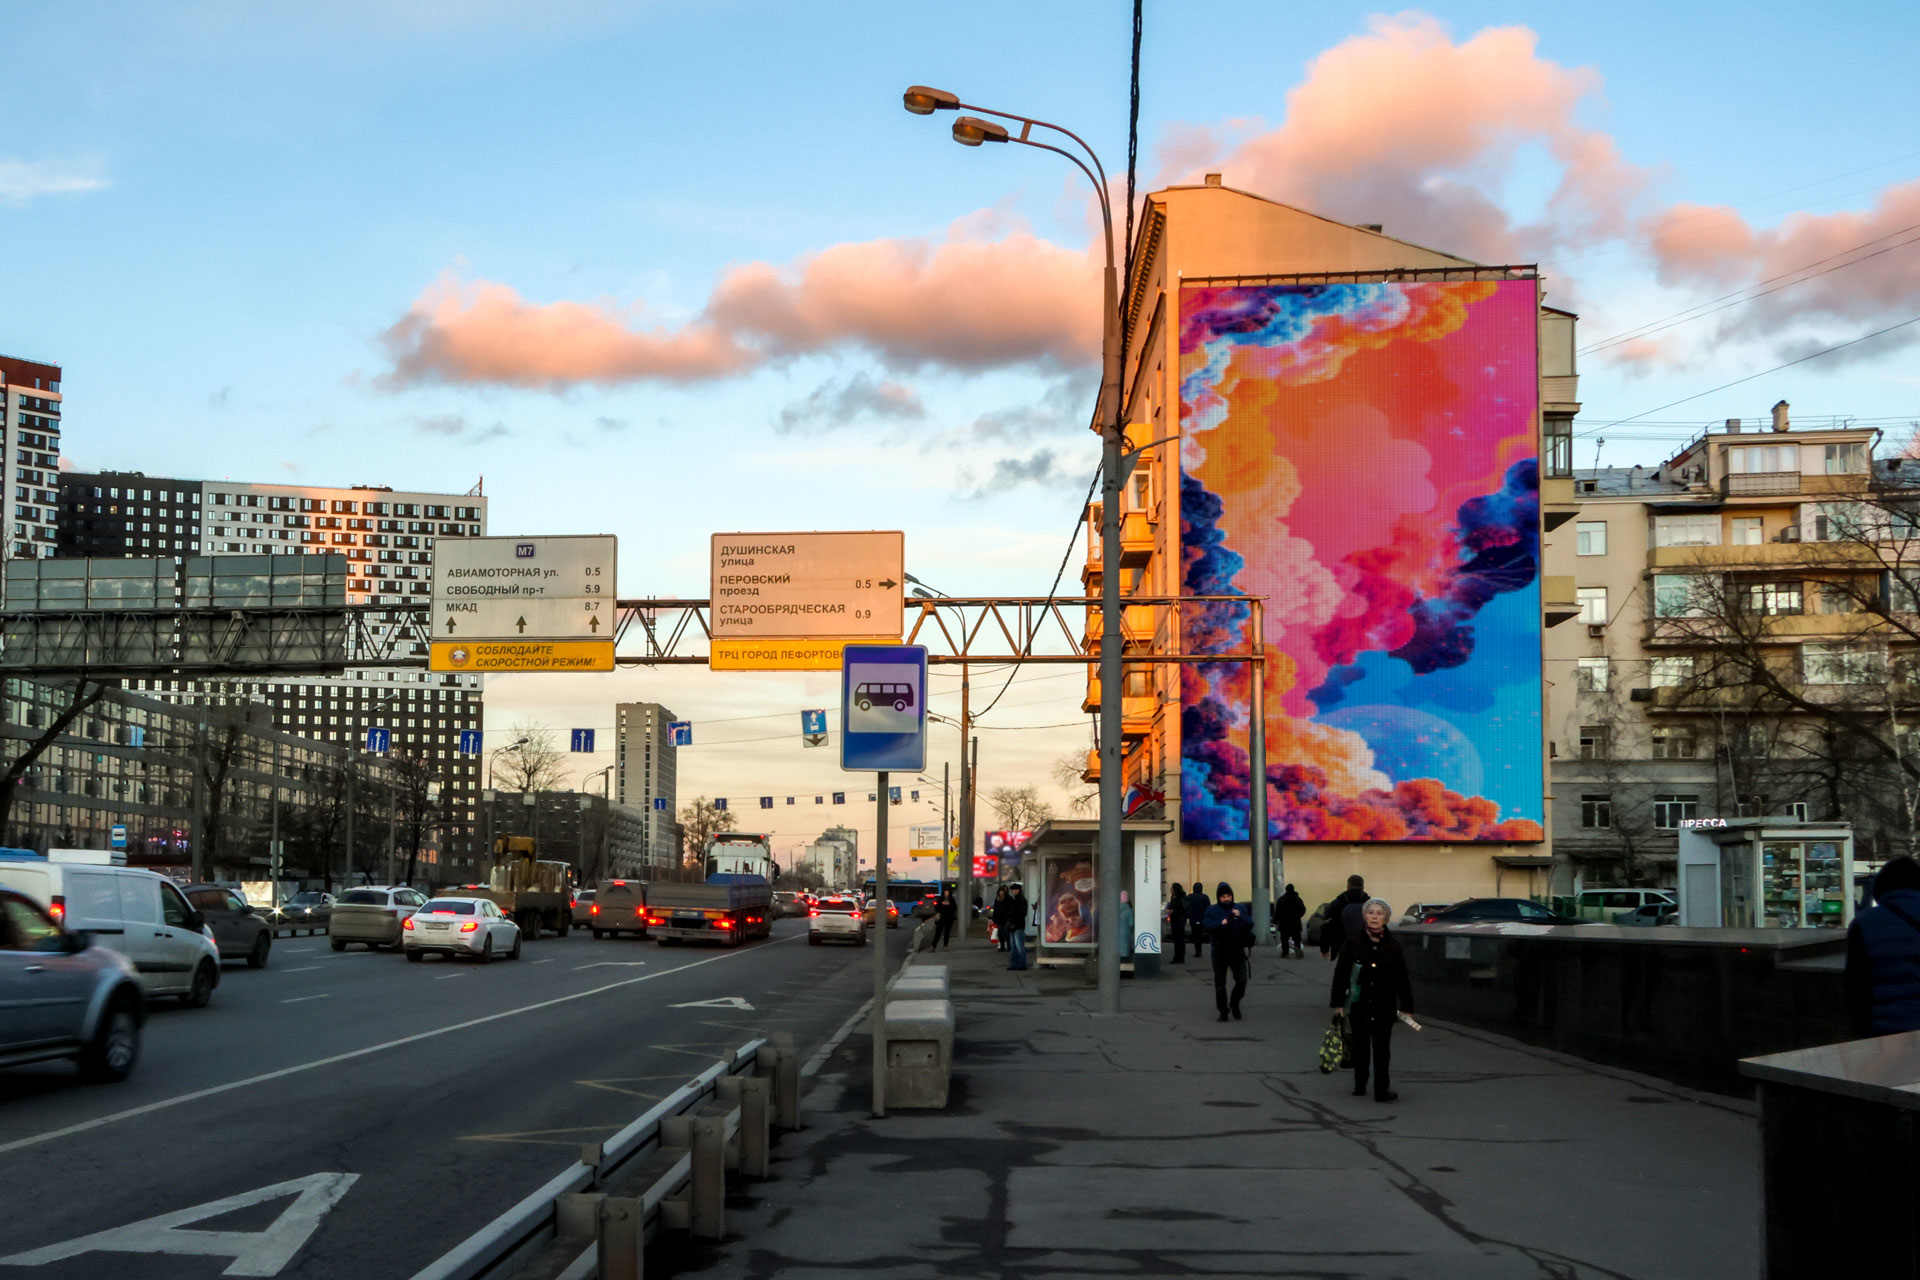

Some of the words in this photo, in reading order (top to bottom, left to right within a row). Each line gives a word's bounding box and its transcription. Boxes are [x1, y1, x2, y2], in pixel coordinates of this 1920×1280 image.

[720, 545, 795, 556] ДУШИНСКАЯ
[720, 558, 755, 567] улица
[447, 568, 541, 578] АВИАМОТОРНАЯ
[543, 569, 559, 580] ул.
[585, 567, 601, 577] 0.5
[720, 573, 791, 585] ПЕРОВСКИЙ
[855, 579, 872, 589] 0.5
[446, 584, 520, 596] СВОБОДНЫЙ
[522, 587, 545, 597] пр-т
[585, 584, 601, 594] 5.9
[720, 587, 760, 597] проезд
[446, 602, 478, 613] МКАД
[584, 601, 600, 611] 8.7
[720, 603, 846, 616] СТАРООБРЯДЧЕСКАЯ
[855, 610, 872, 619] 0.9
[720, 617, 753, 627] улица
[476, 645, 553, 657] СОБЛЮДАЙТЕ
[718, 650, 739, 661] ТРЦ
[742, 650, 778, 661] ГОРОД
[476, 657, 551, 668] СКОРОСТНОЙ
[551, 657, 596, 668] РЕЖИМ!
[1680, 818, 1728, 829] ПРЕССА
